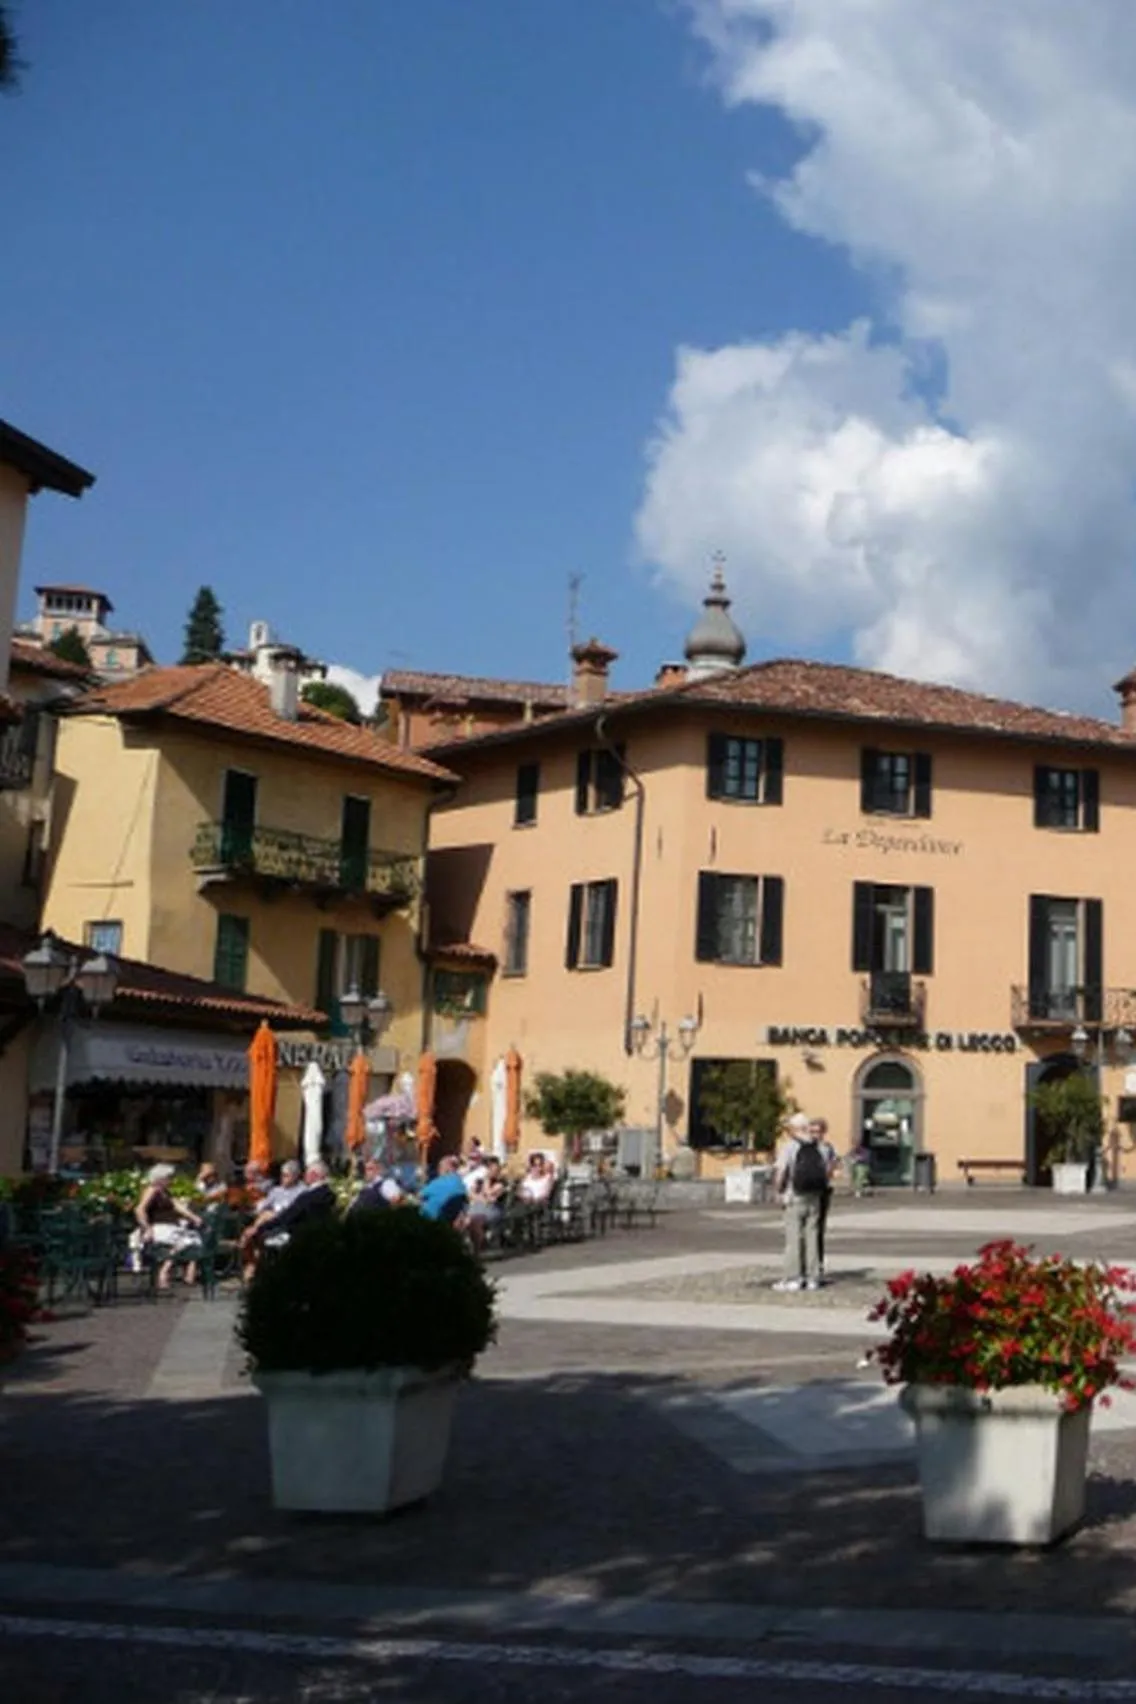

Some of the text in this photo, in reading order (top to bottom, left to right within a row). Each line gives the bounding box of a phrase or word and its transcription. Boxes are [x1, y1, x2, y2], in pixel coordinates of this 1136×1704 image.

[767, 1026, 1017, 1055] BANCA POPORE DI LECCO
